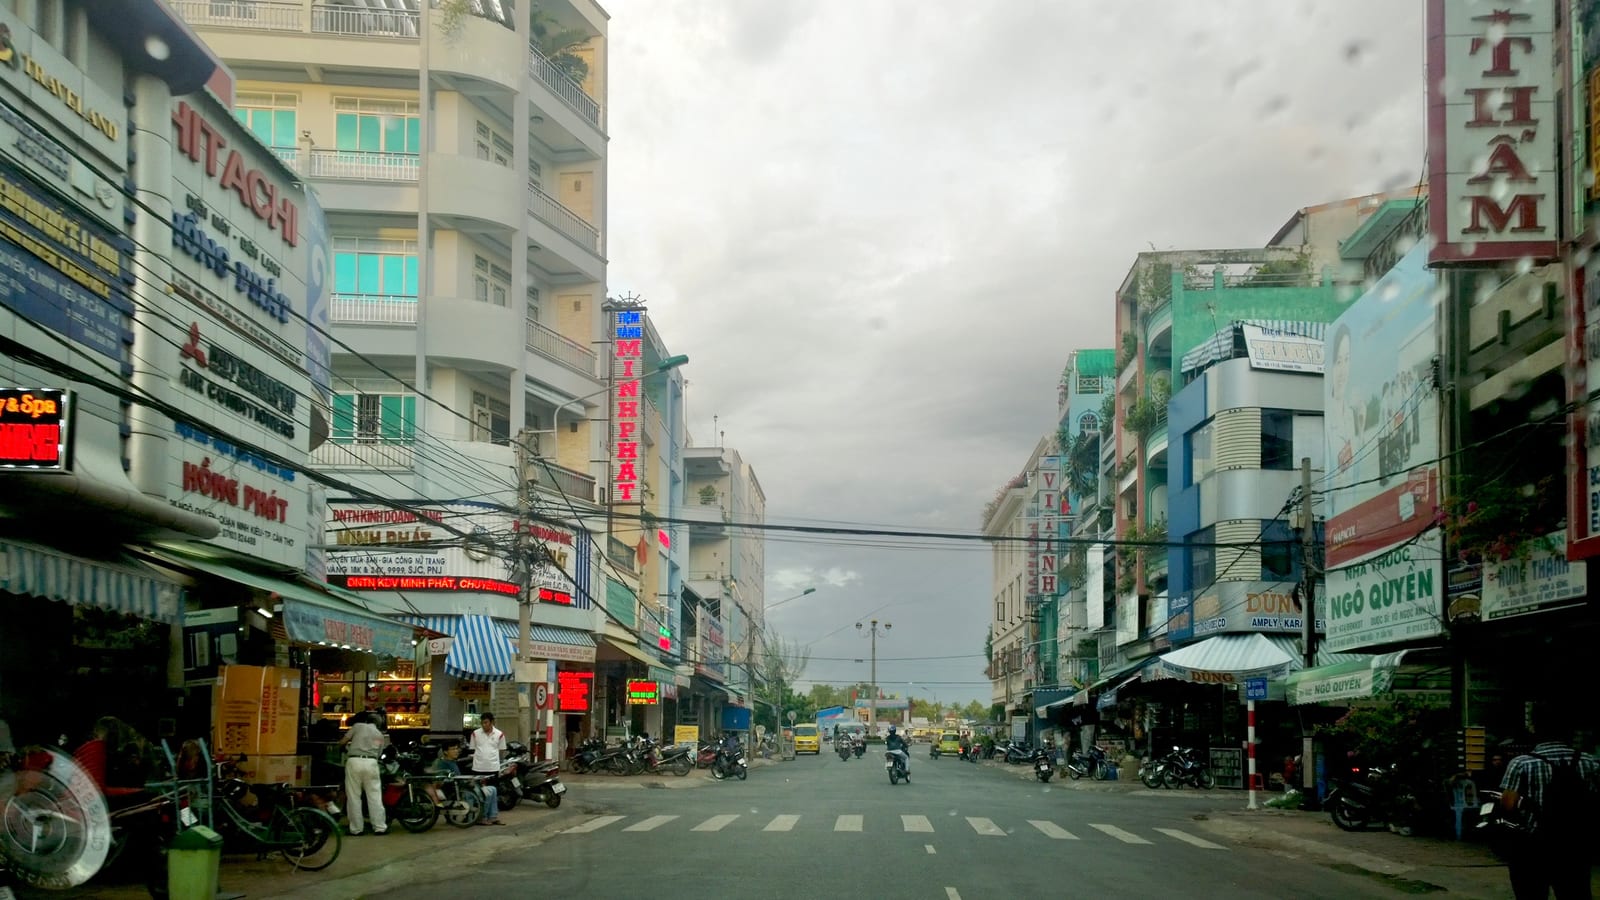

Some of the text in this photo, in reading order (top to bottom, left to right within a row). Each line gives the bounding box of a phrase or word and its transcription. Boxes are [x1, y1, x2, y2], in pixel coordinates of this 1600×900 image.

[172, 100, 297, 248] HITACHI
[180, 368, 204, 395] AIR
[20, 394, 56, 418] Spa
[243, 489, 288, 524] PHÁT
[401, 577, 427, 587] MINH
[427, 565, 443, 575] PNJ
[1246, 590, 1304, 614] DŨN
[1331, 560, 1434, 620] NGÔ QUYỀN
[1217, 618, 1226, 628] CD
[1252, 618, 1278, 628] AMPLY
